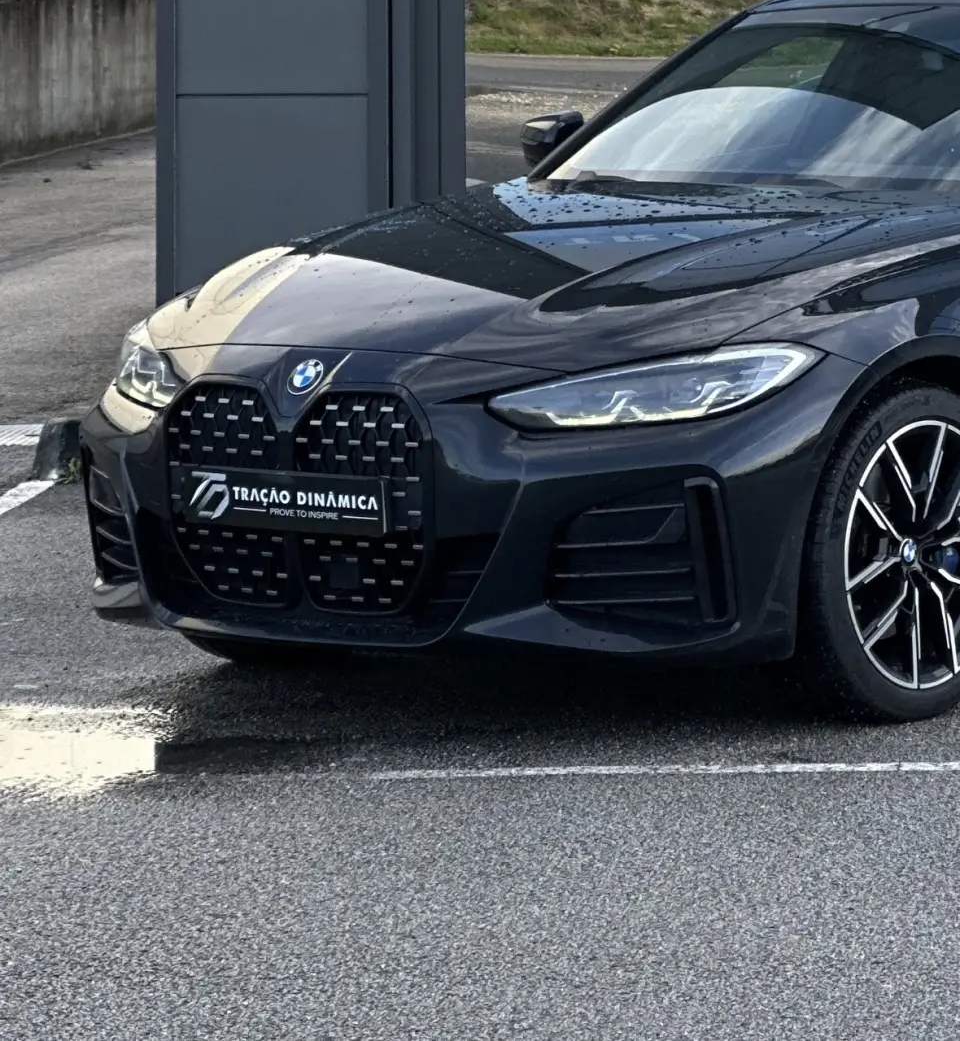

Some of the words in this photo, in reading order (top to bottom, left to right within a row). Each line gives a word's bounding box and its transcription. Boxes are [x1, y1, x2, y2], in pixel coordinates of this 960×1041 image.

[232, 486, 291, 507] TRAÇÃO
[297, 491, 379, 511] DINÂMICA
[269, 507, 295, 518] PROVE
[296, 509, 307, 518] TO
[308, 510, 339, 521] INSPIRE
